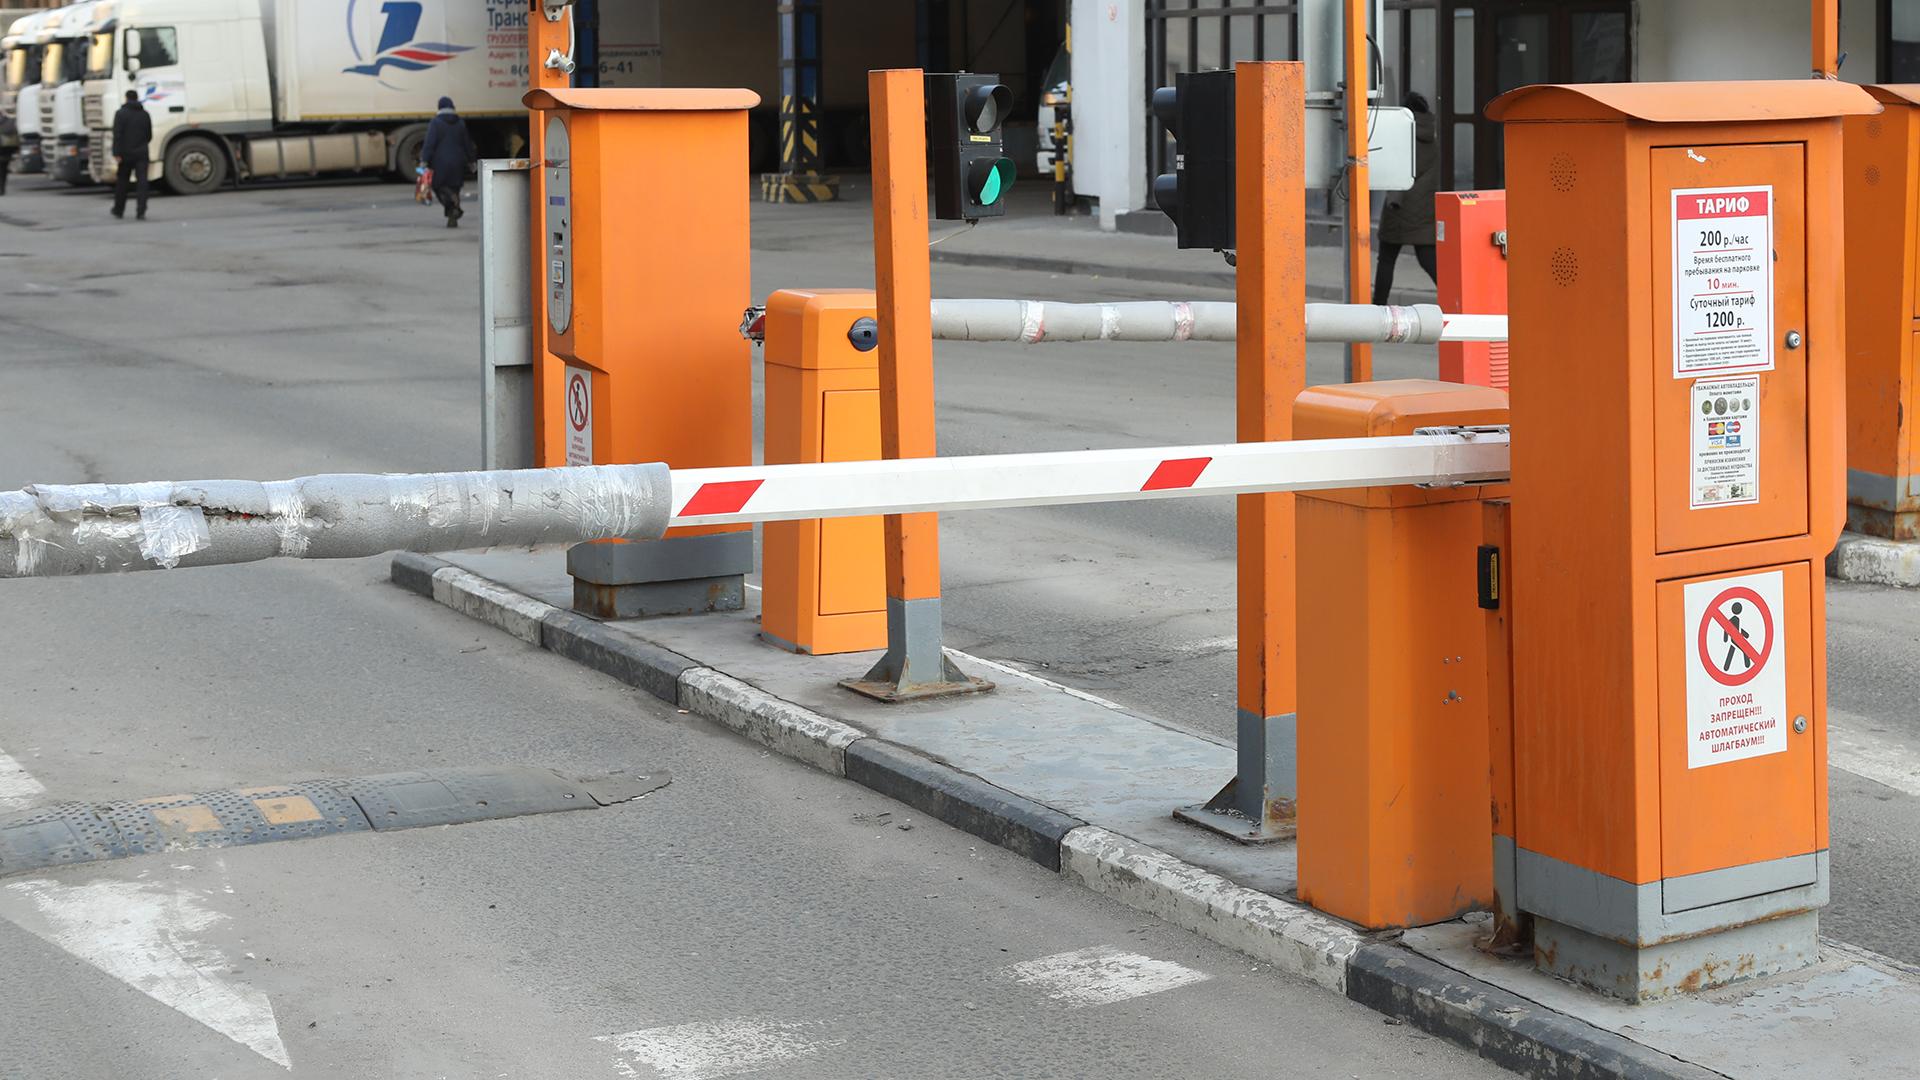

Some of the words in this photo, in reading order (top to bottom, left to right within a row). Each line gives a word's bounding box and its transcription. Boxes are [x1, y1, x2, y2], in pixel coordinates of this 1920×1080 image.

[487, 8, 528, 30] Транс
[1696, 196, 1750, 214] ТАРИФ
[1700, 230, 1722, 246] 200
[1723, 234, 1749, 248] р./час
[1693, 255, 1713, 265] Время
[1714, 254, 1751, 263] бесплатного
[1685, 268, 1723, 277] пребывания
[1732, 265, 1760, 274] парковке
[1707, 278, 1720, 290] 10
[1722, 281, 1739, 289] мин.
[1690, 296, 1730, 311] Суточный
[1731, 294, 1755, 307] тариф
[1706, 311, 1734, 328] 1200
[1737, 317, 1745, 328] р.
[1719, 693, 1753, 707] ПРОХОД
[1710, 706, 1762, 723] ЗАПРЕЩЕН!!!
[1699, 717, 1776, 741] АВТОМАТИЧЕСКИЙ
[1711, 735, 1765, 753] ШЛАГБАУМ!!!
